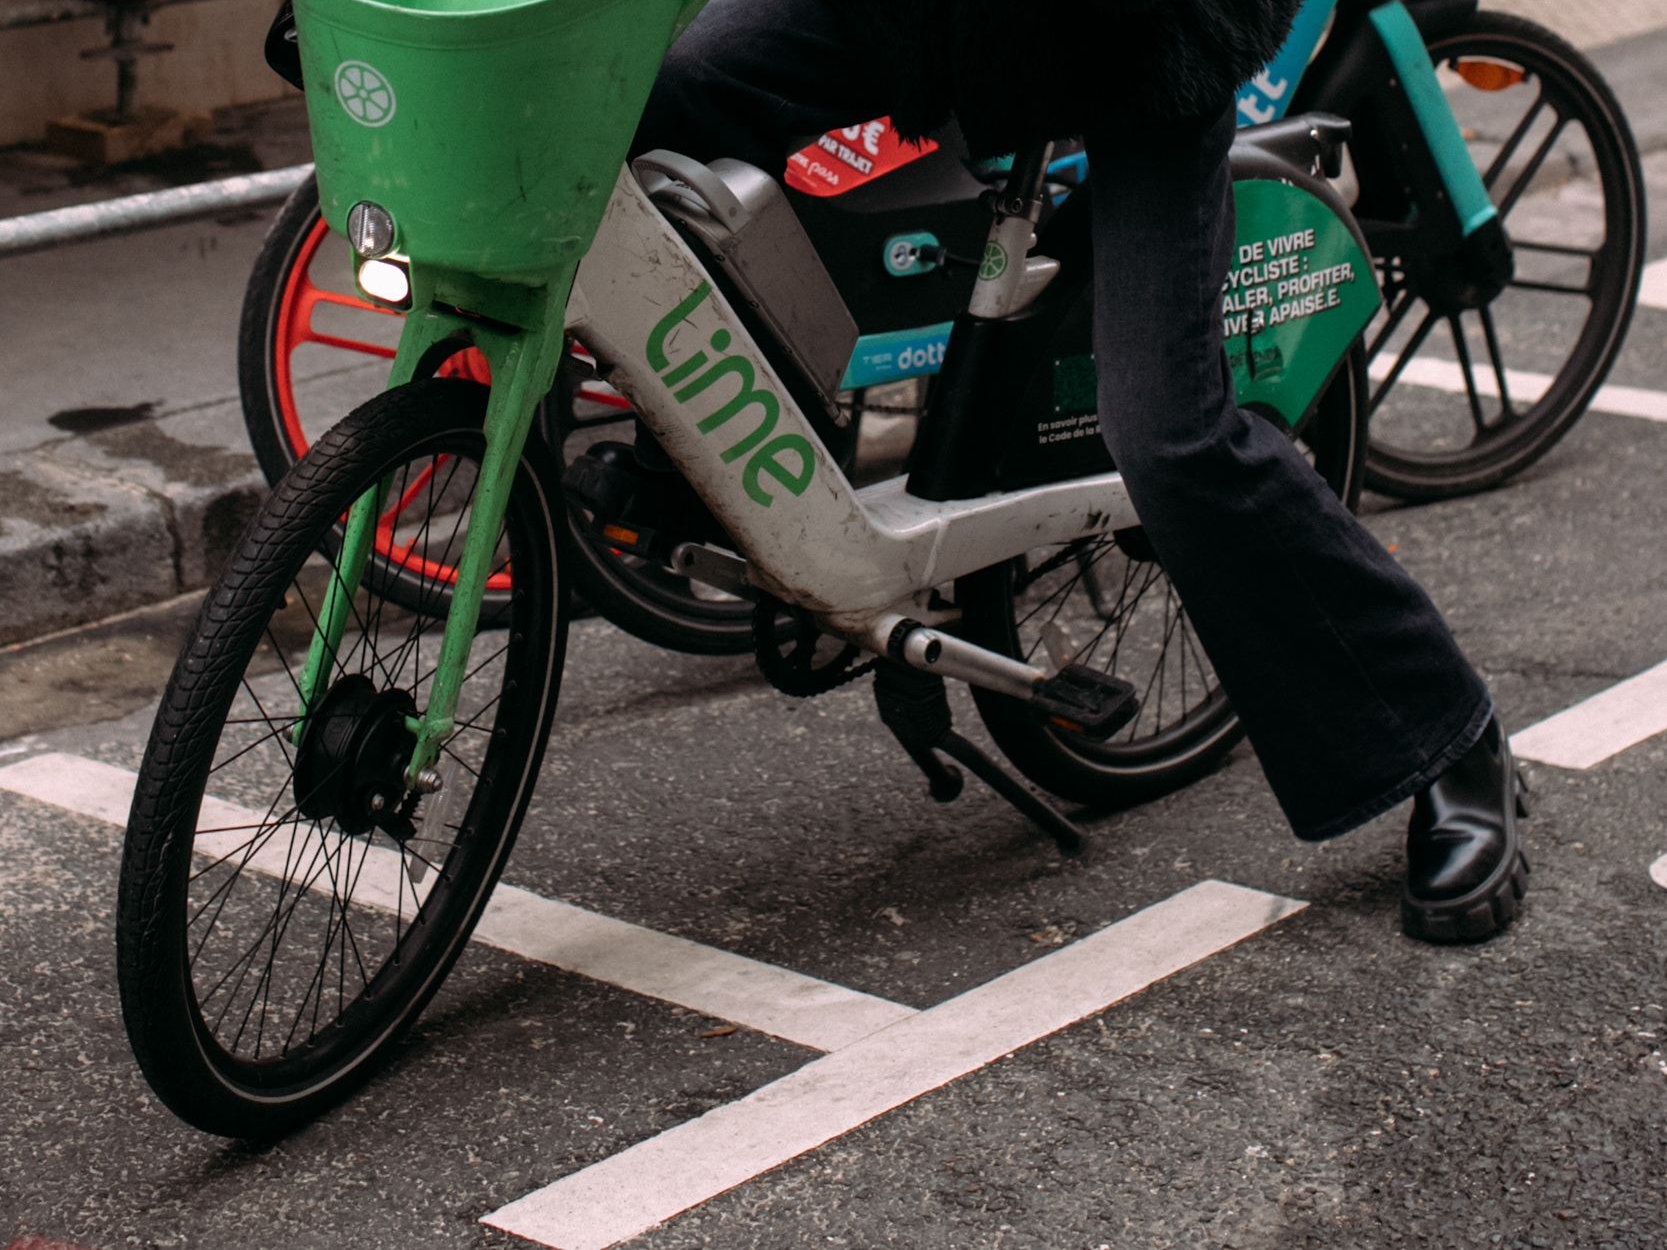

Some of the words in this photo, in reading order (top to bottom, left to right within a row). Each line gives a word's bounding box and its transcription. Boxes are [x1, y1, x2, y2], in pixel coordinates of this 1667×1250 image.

[817, 134, 837, 156] PAR
[837, 145, 873, 175] TRAJET
[1239, 242, 1264, 264] DE
[1267, 229, 1315, 257] VIVRE
[1278, 263, 1355, 300] PROFITER,
[898, 342, 946, 370] dott
[1038, 423, 1049, 431] En
[1050, 416, 1077, 430] savoir
[1079, 414, 1098, 427] plus
[1039, 435, 1047, 444] le
[1049, 431, 1072, 443] Code
[1073, 428, 1084, 438] de
[1086, 426, 1094, 436] la
